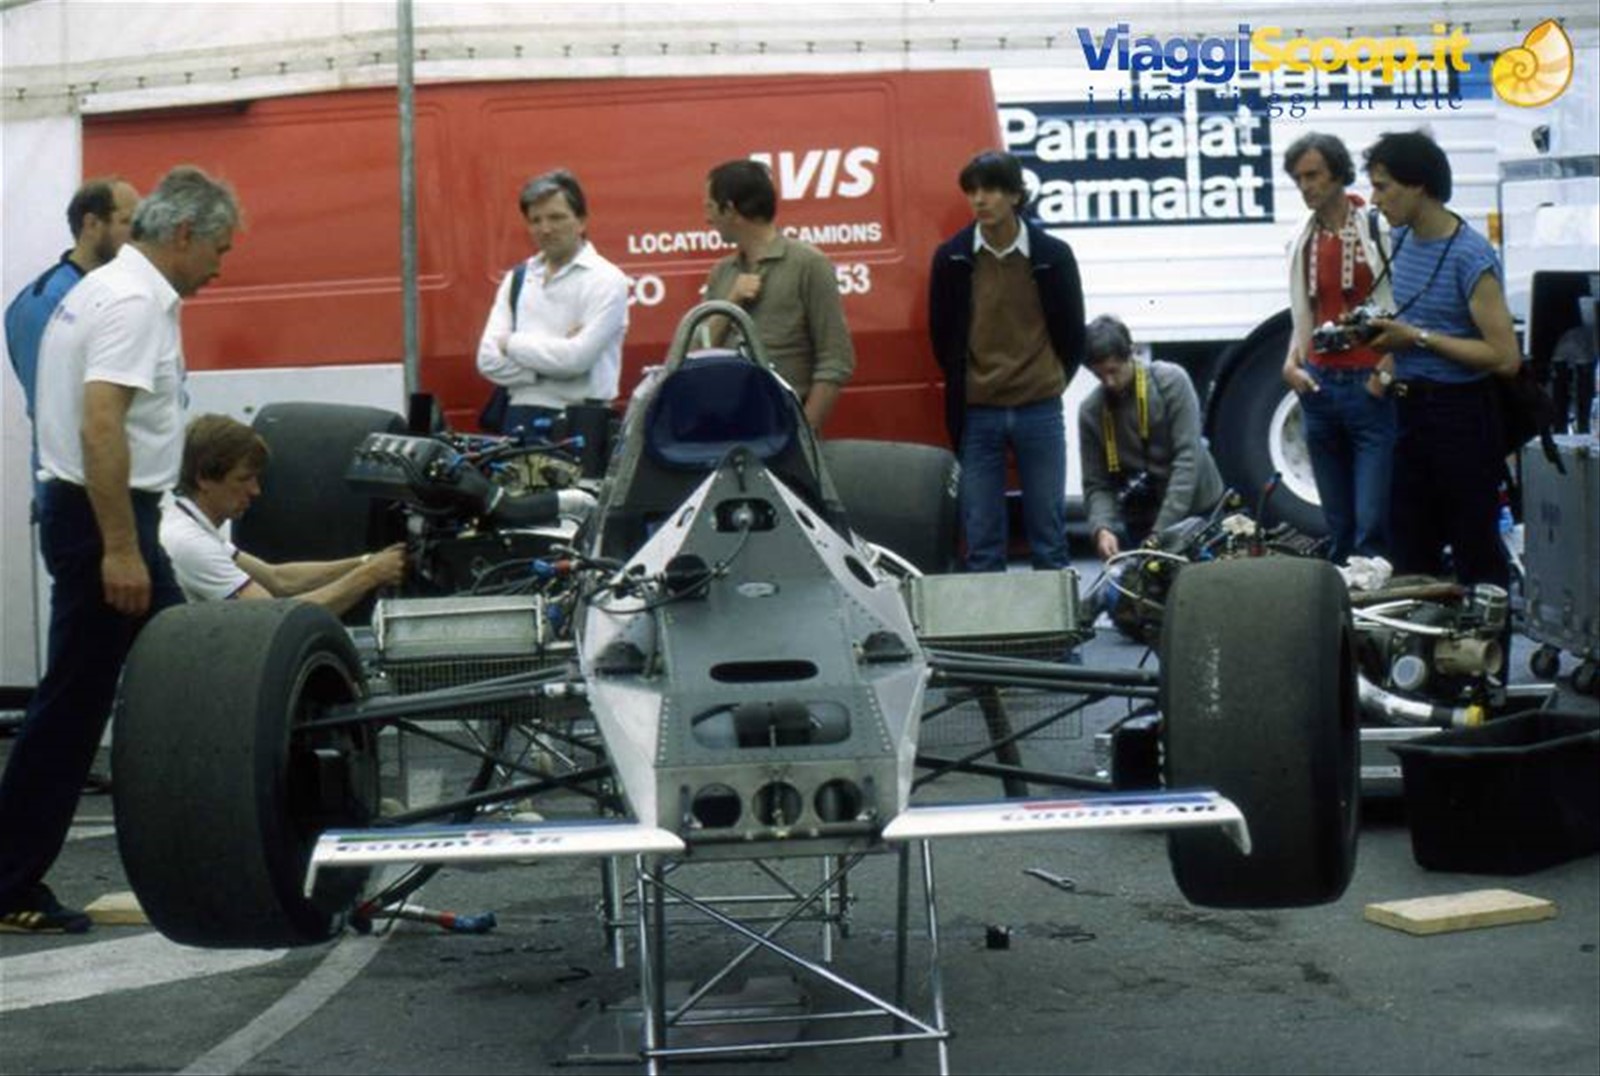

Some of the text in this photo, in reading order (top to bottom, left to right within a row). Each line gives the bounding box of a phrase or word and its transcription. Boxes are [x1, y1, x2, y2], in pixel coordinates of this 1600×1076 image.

[999, 103, 1262, 162] Parmalat
[750, 146, 880, 200] VIS
[627, 222, 882, 254] LOCATIO CAMIONS
